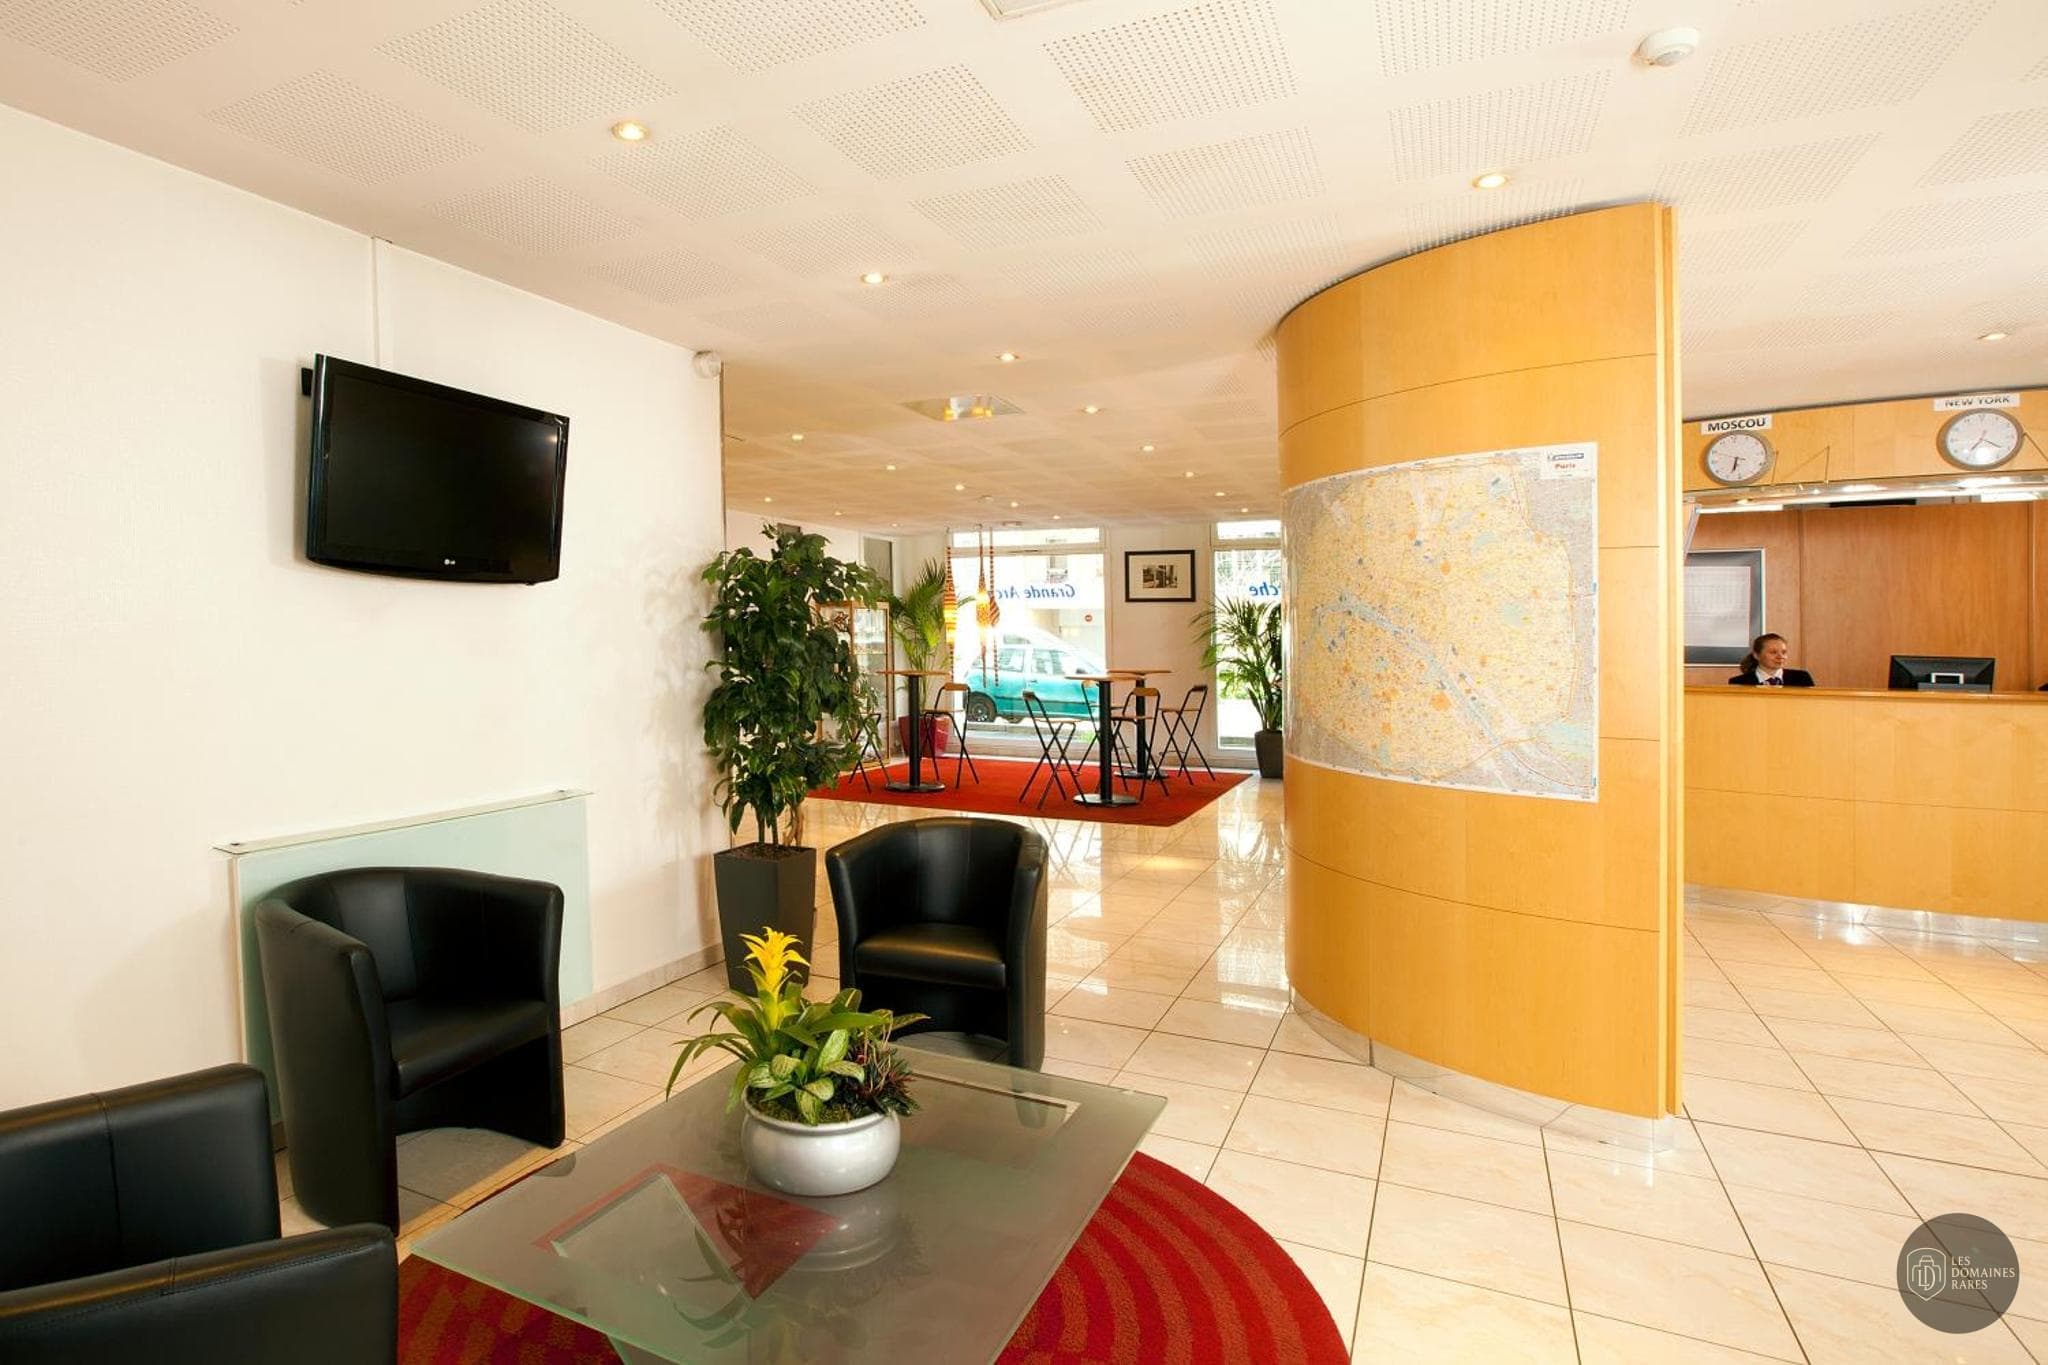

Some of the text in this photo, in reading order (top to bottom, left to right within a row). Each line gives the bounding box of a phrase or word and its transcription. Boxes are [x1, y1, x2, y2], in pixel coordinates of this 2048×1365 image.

[1945, 395, 2010, 407] NEW YORK
[1707, 417, 1767, 432] MOSCOU
